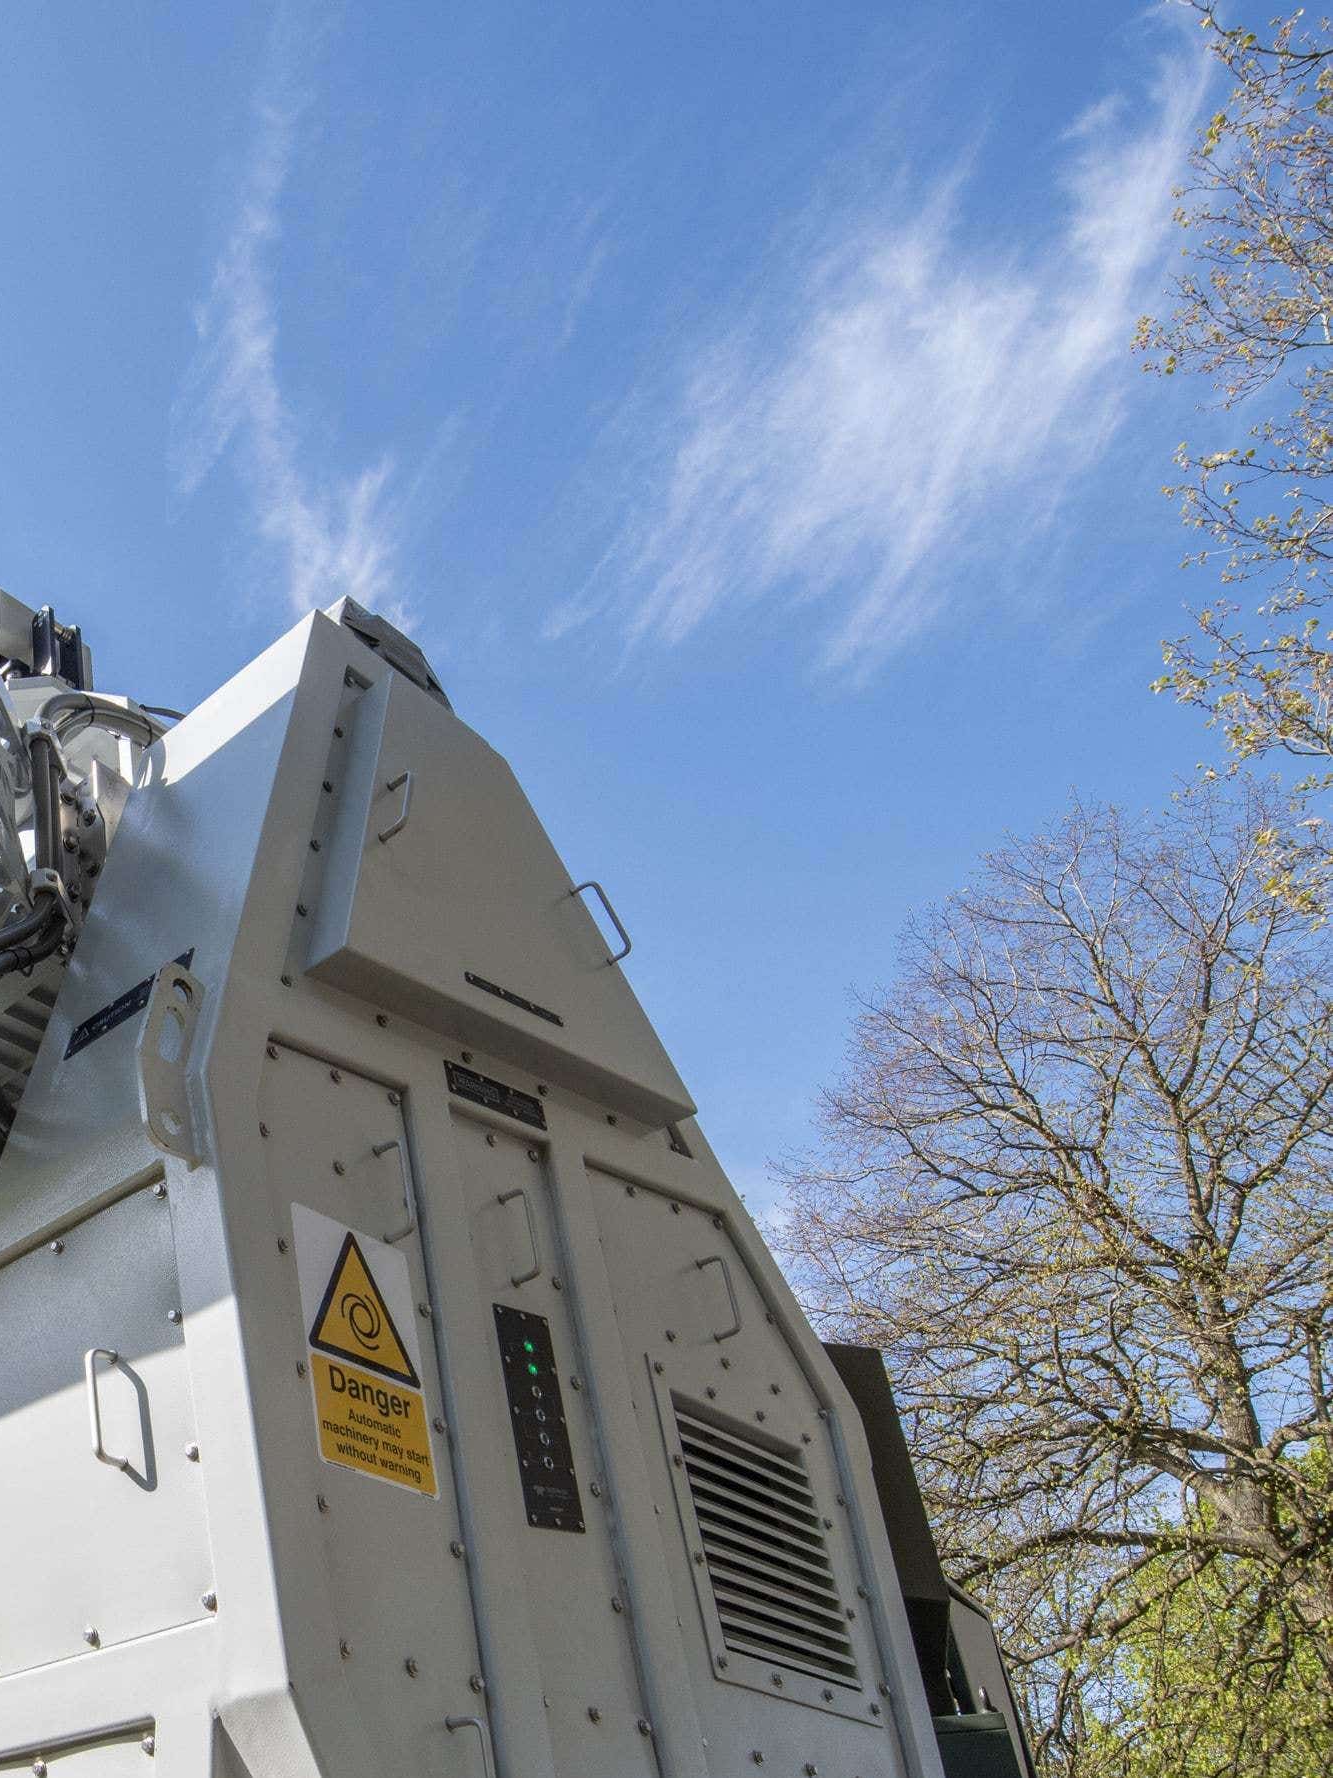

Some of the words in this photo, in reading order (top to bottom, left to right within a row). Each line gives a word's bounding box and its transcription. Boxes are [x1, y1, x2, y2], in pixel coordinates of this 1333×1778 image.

[329, 1364, 410, 1418] Danger
[322, 1419, 379, 1450] machinery
[382, 1441, 404, 1459] may
[406, 1448, 430, 1467] start
[348, 1408, 401, 1439] Automatic
[336, 1442, 378, 1466] without
[380, 1457, 422, 1484] warning
